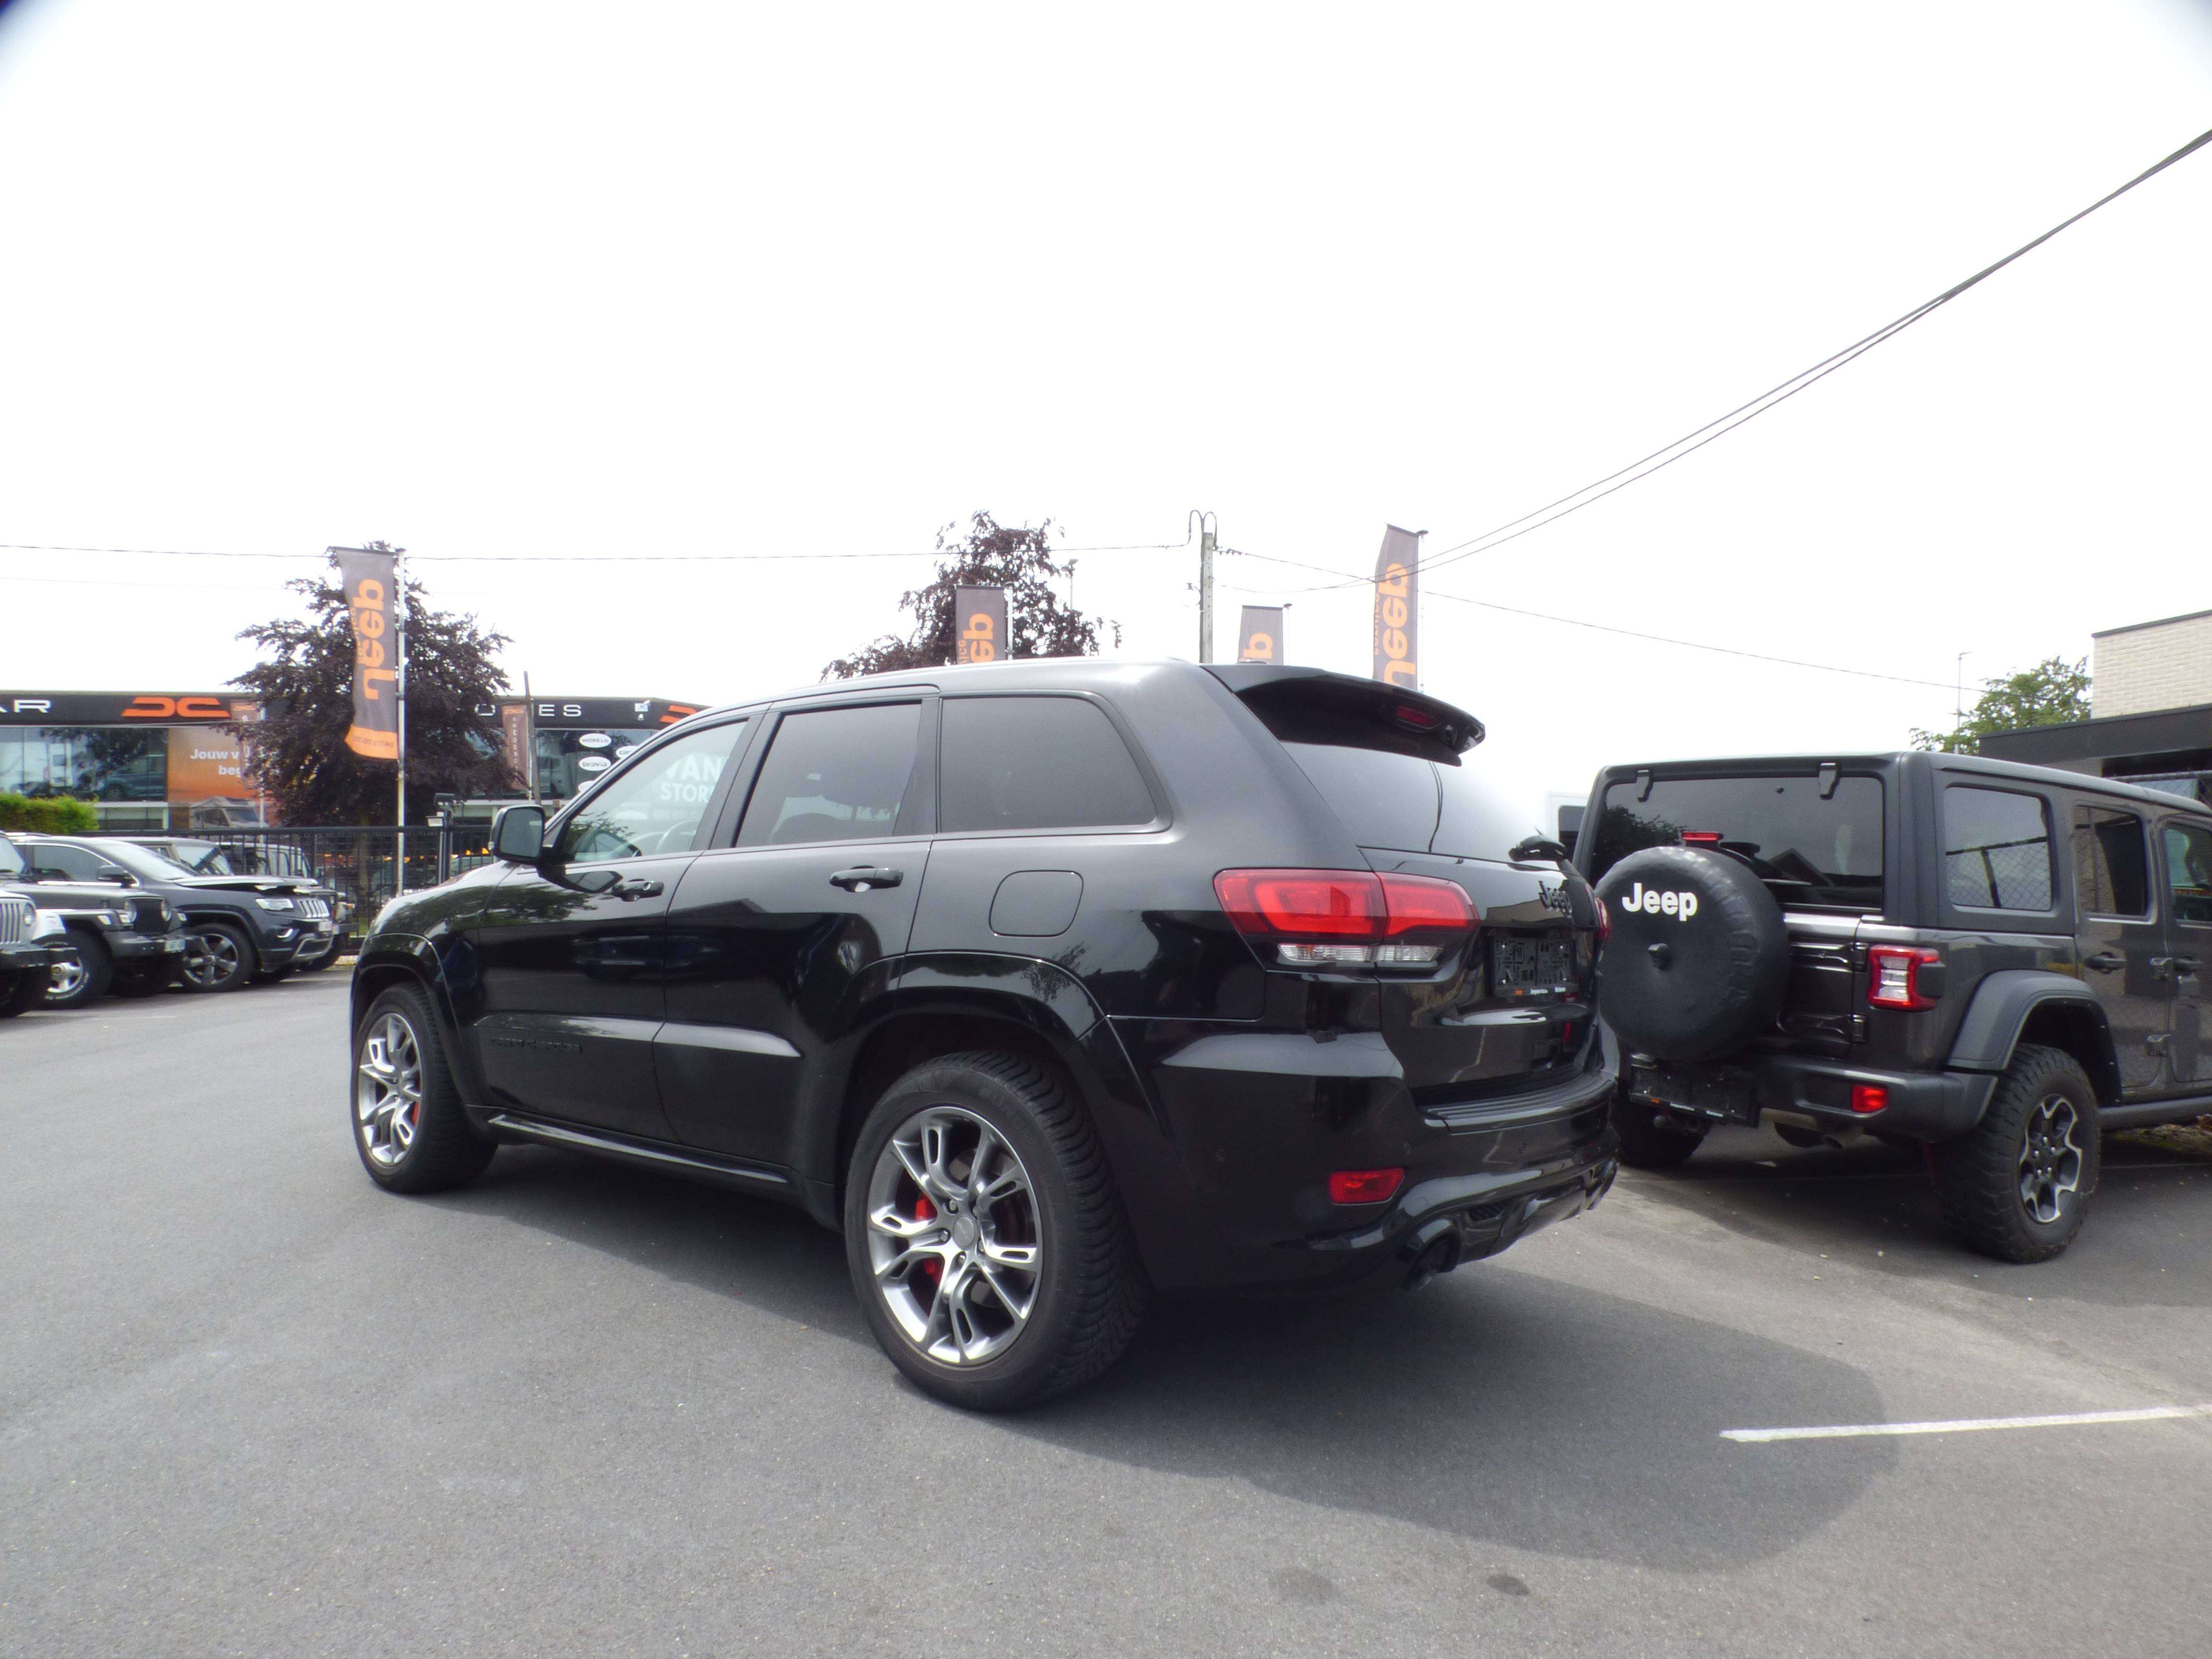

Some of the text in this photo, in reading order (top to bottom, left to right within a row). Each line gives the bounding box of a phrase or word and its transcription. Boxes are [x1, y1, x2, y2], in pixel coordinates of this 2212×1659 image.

[190, 749, 228, 759] Jouw
[660, 781, 716, 803] STOR
[1538, 880, 1573, 916] Jeep
[1622, 882, 1698, 922] Jeep
